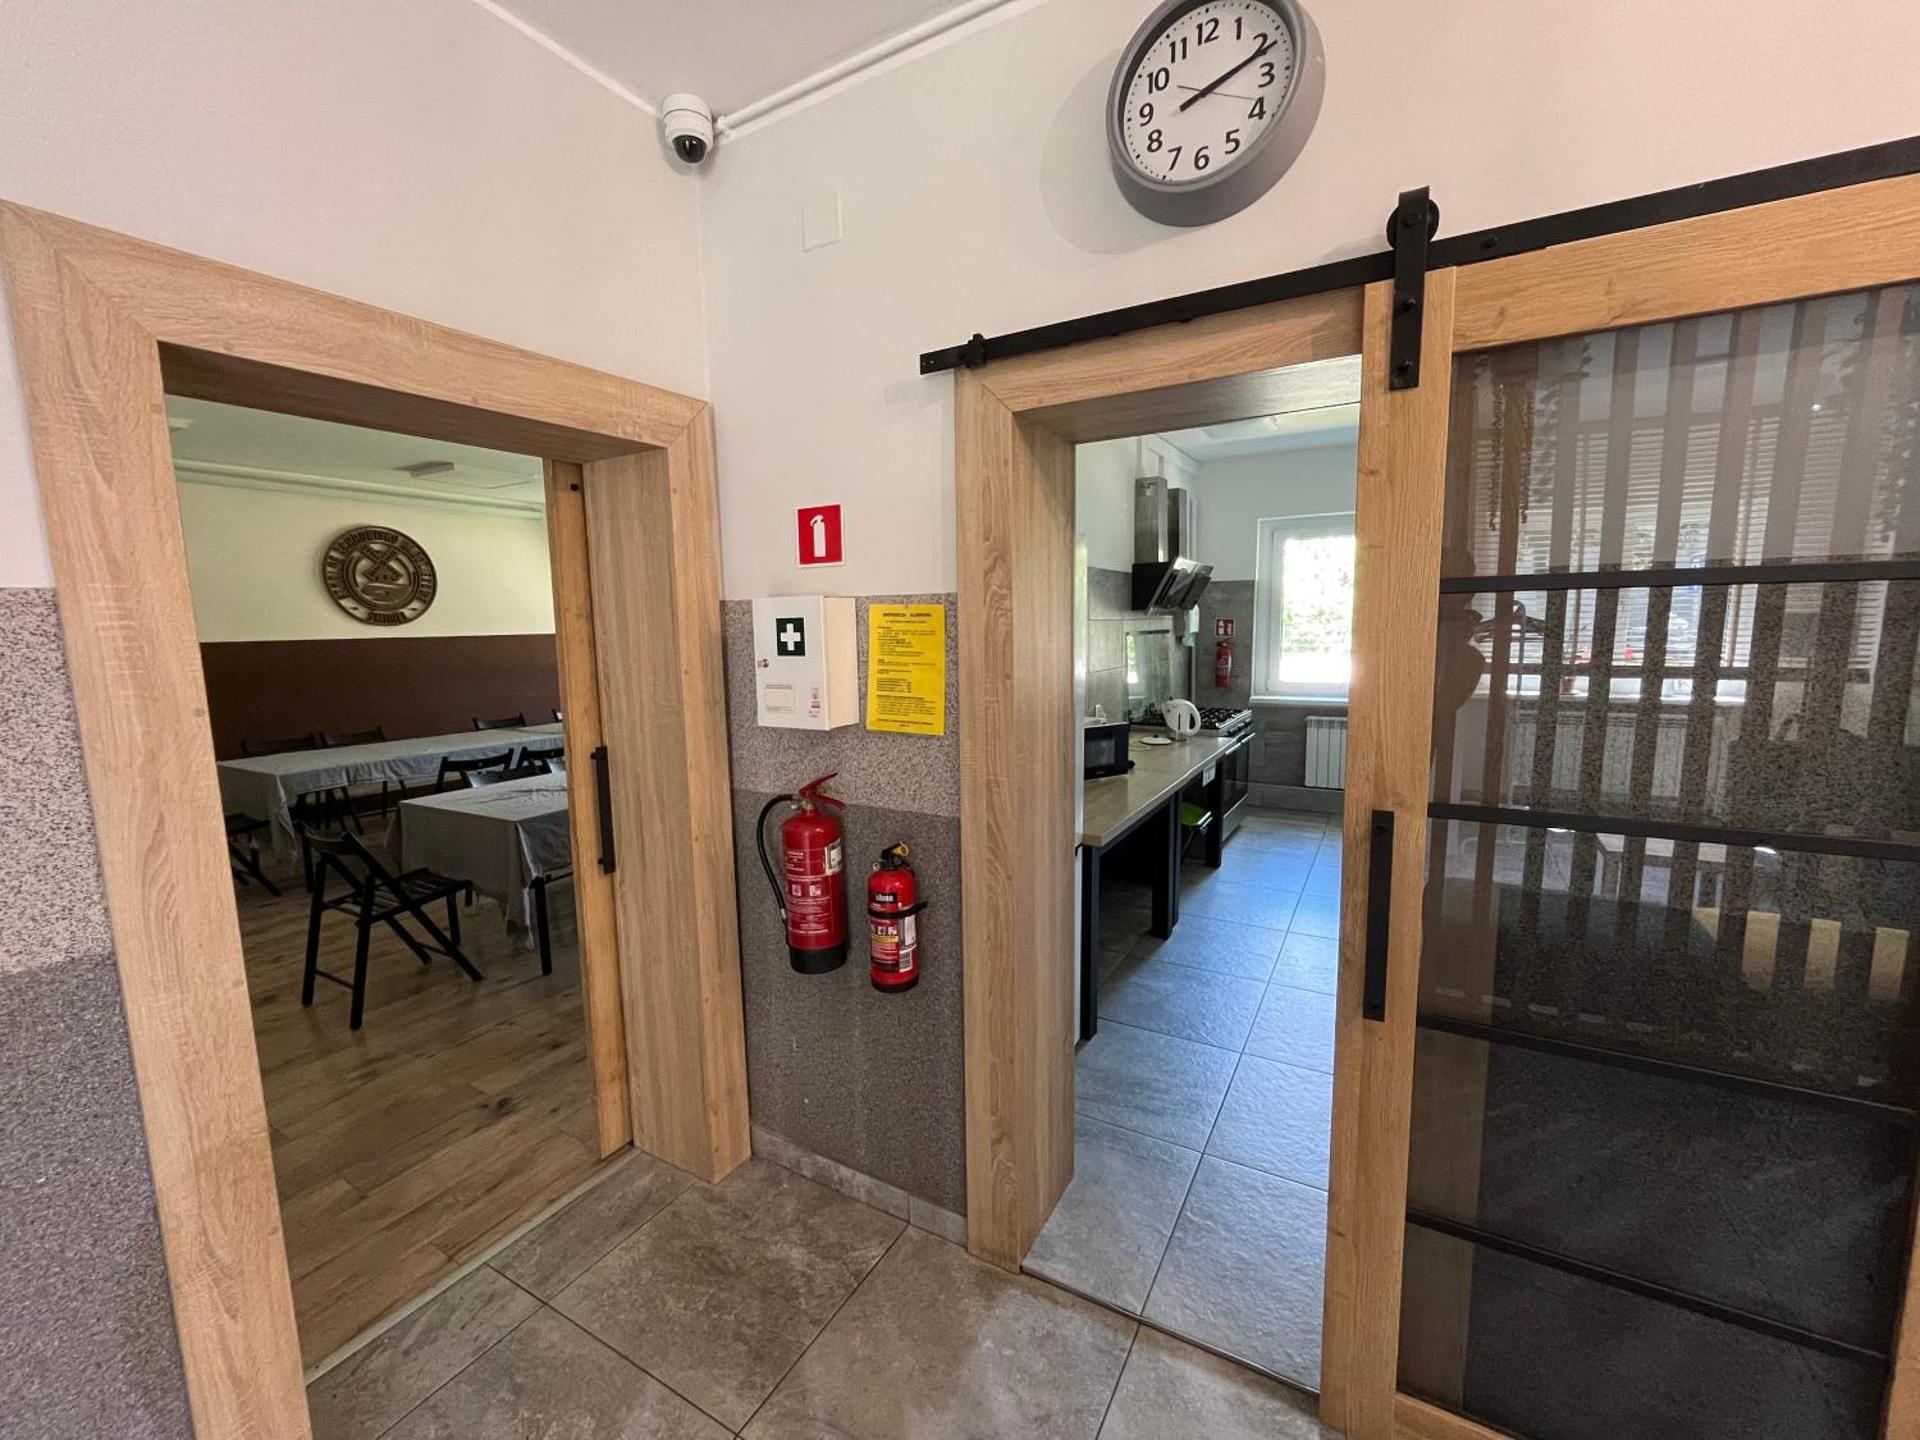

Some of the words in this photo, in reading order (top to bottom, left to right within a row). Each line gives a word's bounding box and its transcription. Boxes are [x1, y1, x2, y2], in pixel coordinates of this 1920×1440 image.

[1196, 17, 1220, 46] 12
[1234, 16, 1243, 41] 1
[1169, 37, 1188, 63] 11
[1252, 33, 1269, 56] 2
[1147, 67, 1170, 94] 10
[1258, 62, 1276, 88] 3
[1139, 102, 1154, 127] 9
[1248, 96, 1267, 121] 4
[1146, 129, 1163, 153] 8
[1225, 129, 1241, 154] 5
[1168, 146, 1183, 171] 7
[1194, 146, 1210, 171] 6
